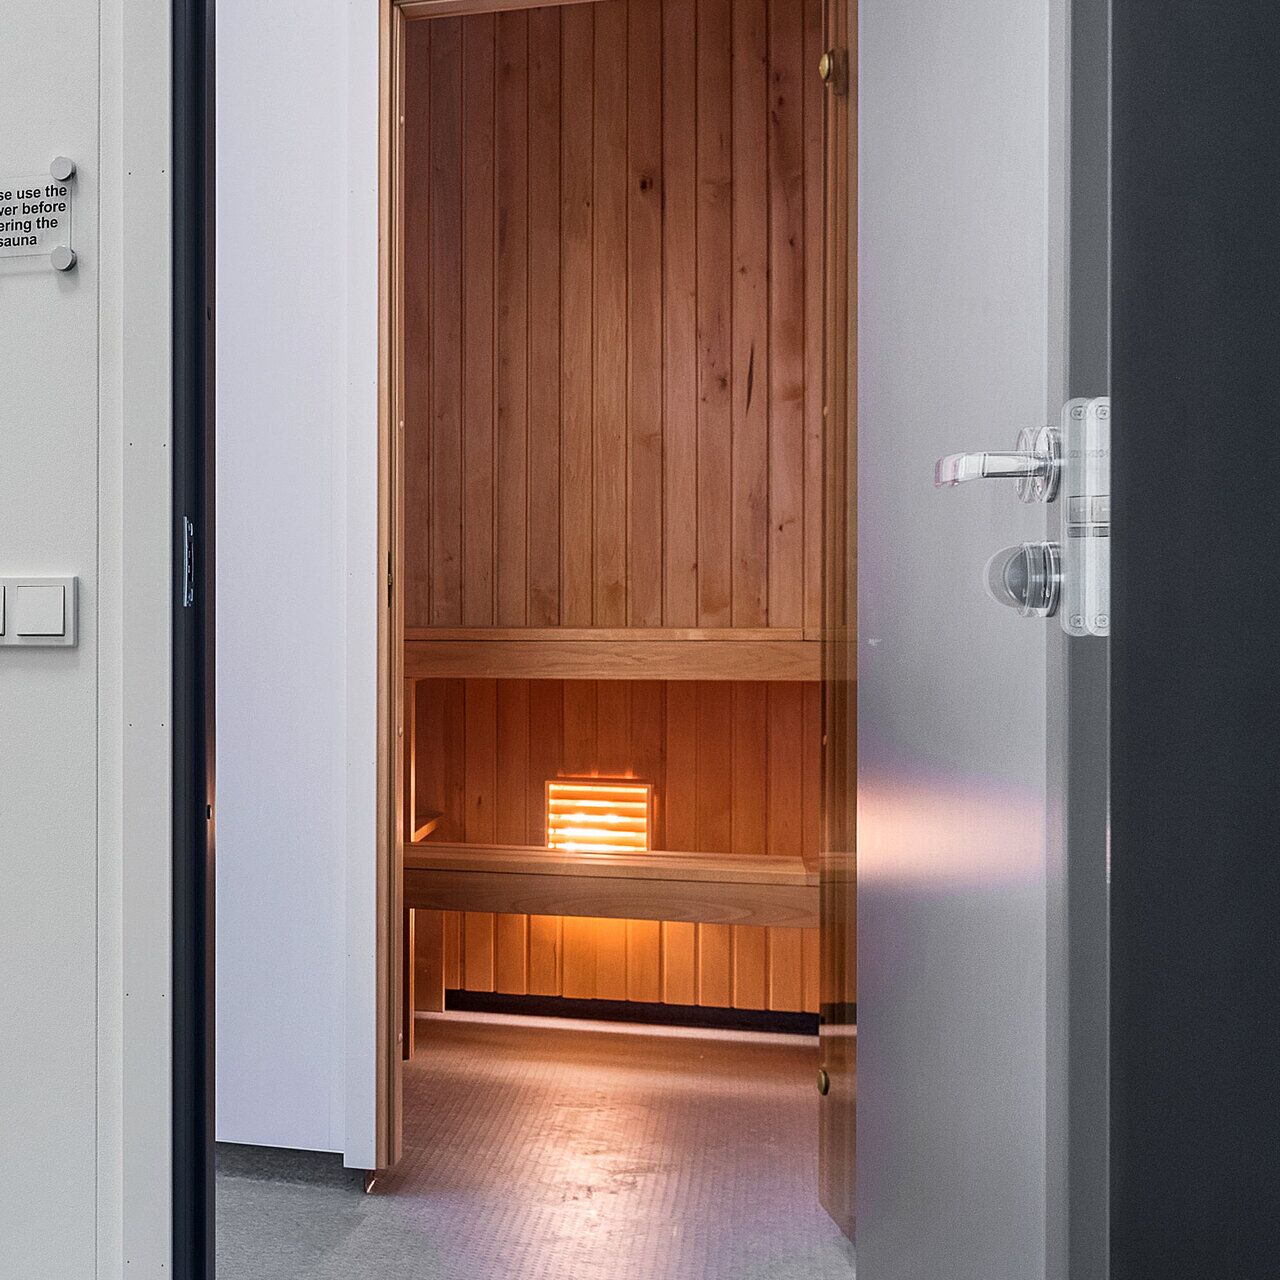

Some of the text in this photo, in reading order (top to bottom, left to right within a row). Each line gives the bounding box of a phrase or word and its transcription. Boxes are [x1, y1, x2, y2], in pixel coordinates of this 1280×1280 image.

[17, 188, 41, 200] use
[45, 185, 67, 197] the
[22, 201, 66, 215] before
[36, 217, 58, 229] the
